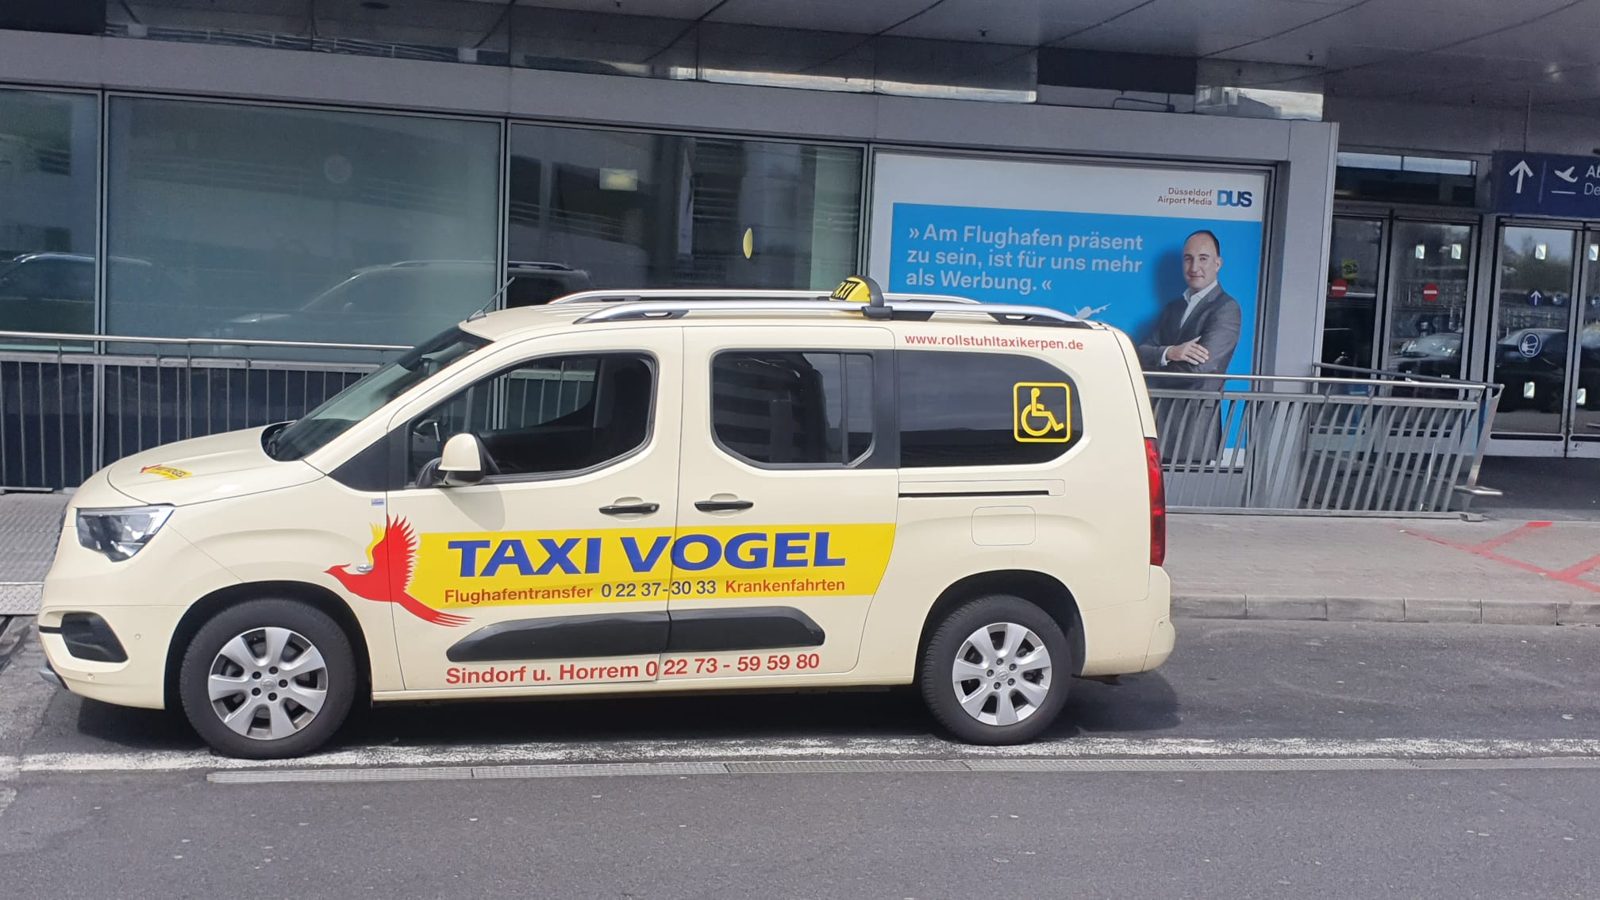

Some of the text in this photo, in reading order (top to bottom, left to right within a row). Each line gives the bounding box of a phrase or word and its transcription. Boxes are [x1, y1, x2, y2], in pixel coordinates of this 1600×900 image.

[1158, 195, 1212, 206] Airport Media
[1168, 187, 1212, 197] Düsseldorf
[1217, 189, 1253, 208] DUS
[963, 225, 1063, 249] Flughafen
[1068, 231, 1143, 251] präsent
[907, 247, 1143, 273] zu sein, ist für uns mehr
[905, 268, 935, 286] als
[904, 334, 1084, 351] www.rollstuhltaxikerpen.de
[448, 532, 846, 577] TAXI VOGEL
[444, 585, 594, 605] Flughafentransfer
[601, 583, 612, 598] 0
[615, 583, 637, 597] 22
[696, 580, 717, 594] 33
[725, 578, 845, 593] Krankenfahrten
[446, 666, 527, 684] Sindorf
[532, 669, 551, 682] u.
[559, 663, 639, 680] Horrem
[645, 661, 658, 677] 0
[663, 659, 688, 675] 22
[694, 657, 719, 673] 73
[737, 656, 761, 672] 59
[766, 654, 791, 670] 59
[796, 653, 820, 669] 80
